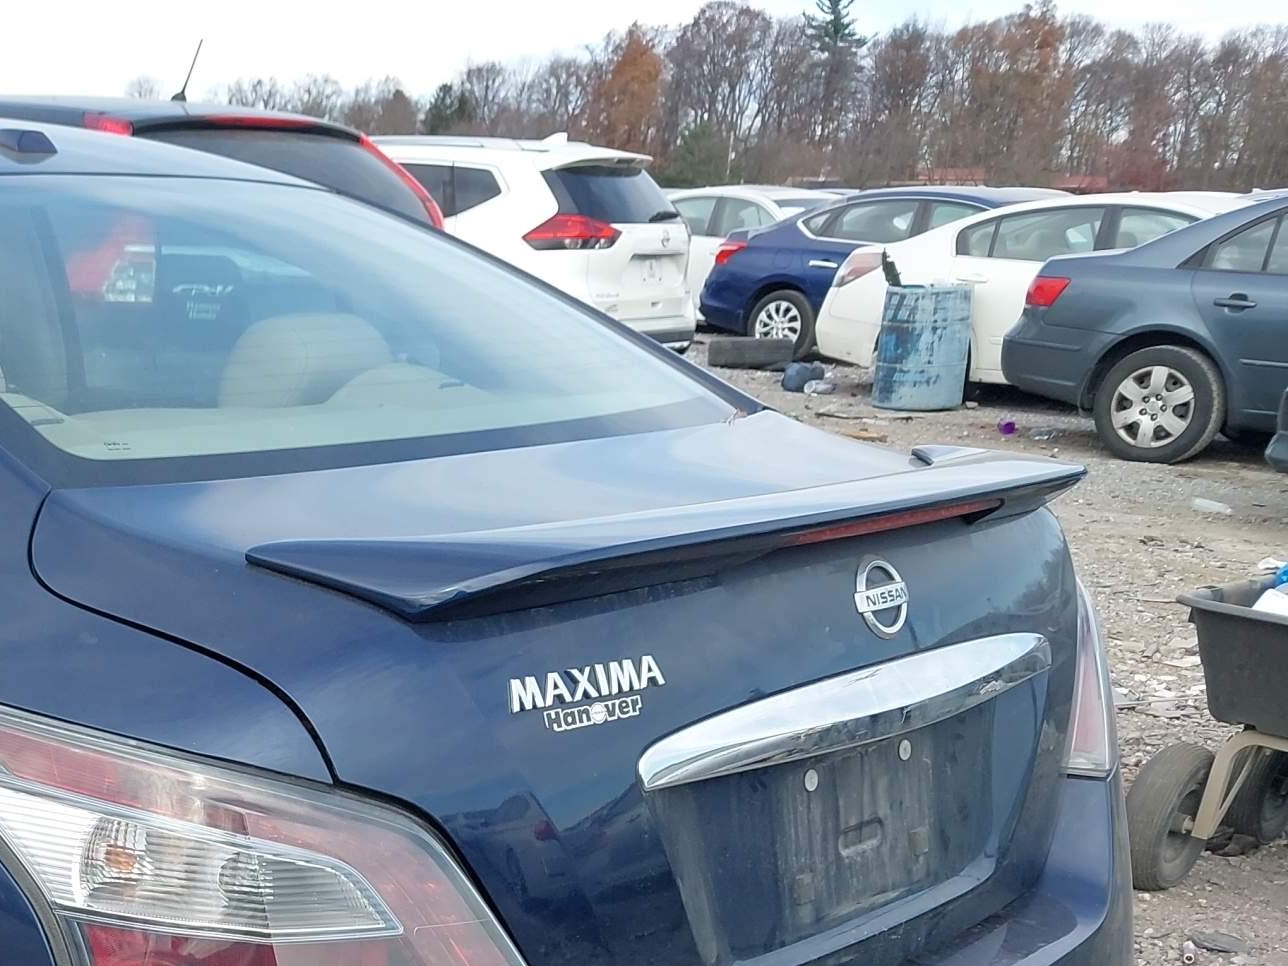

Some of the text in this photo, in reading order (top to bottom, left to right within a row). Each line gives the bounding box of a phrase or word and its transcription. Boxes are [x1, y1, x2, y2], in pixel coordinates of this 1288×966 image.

[865, 587, 907, 607] NISSAN
[509, 655, 666, 713] MAXIMA
[544, 696, 641, 731] Hanover
